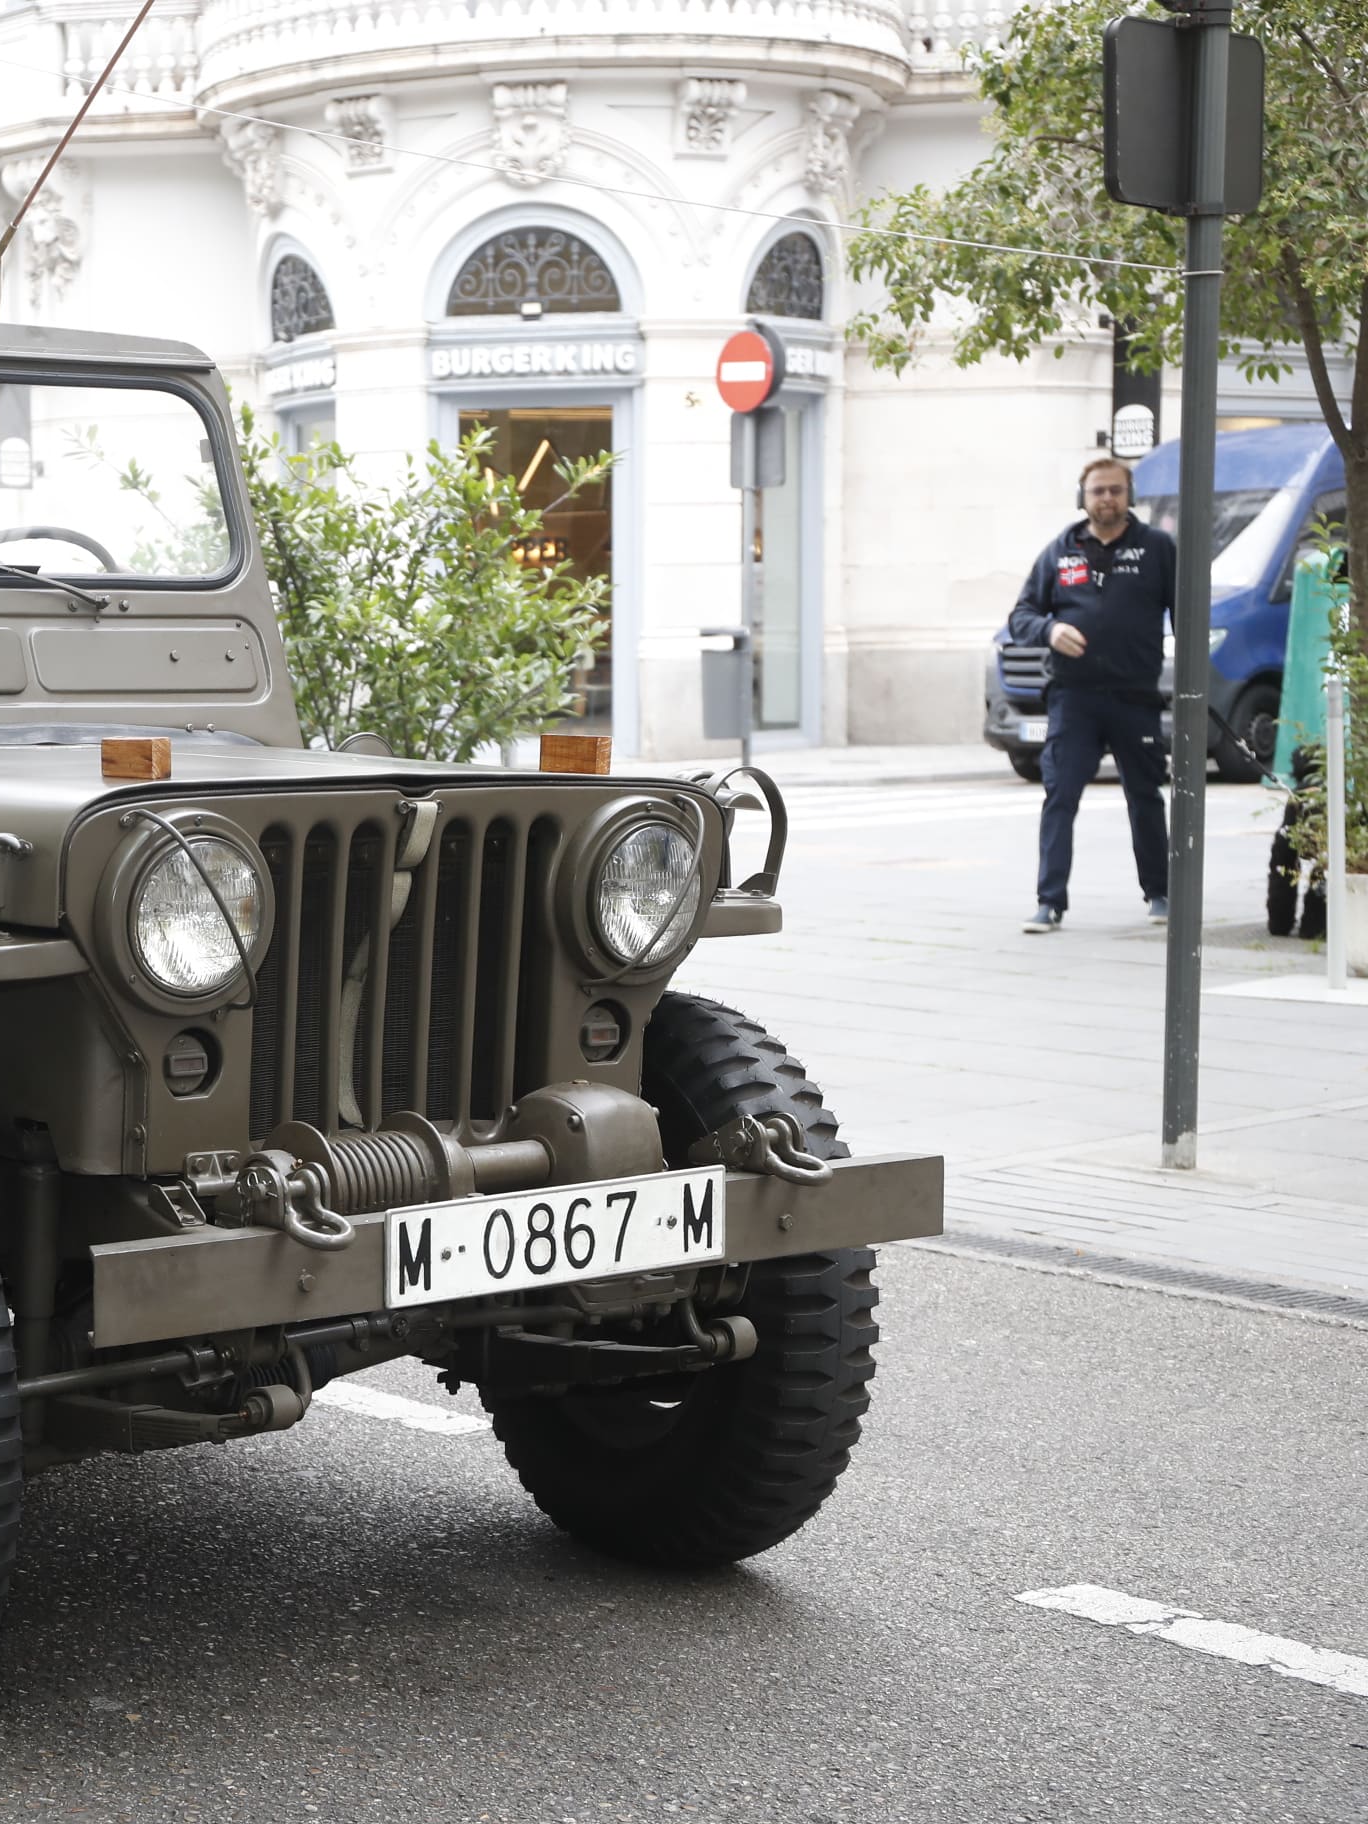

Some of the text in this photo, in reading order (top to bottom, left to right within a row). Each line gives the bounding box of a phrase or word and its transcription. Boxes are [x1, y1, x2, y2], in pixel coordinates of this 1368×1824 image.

[432, 344, 636, 378] BURGER KING
[1114, 431, 1153, 447] KING
[483, 1189, 638, 1280] 0867
